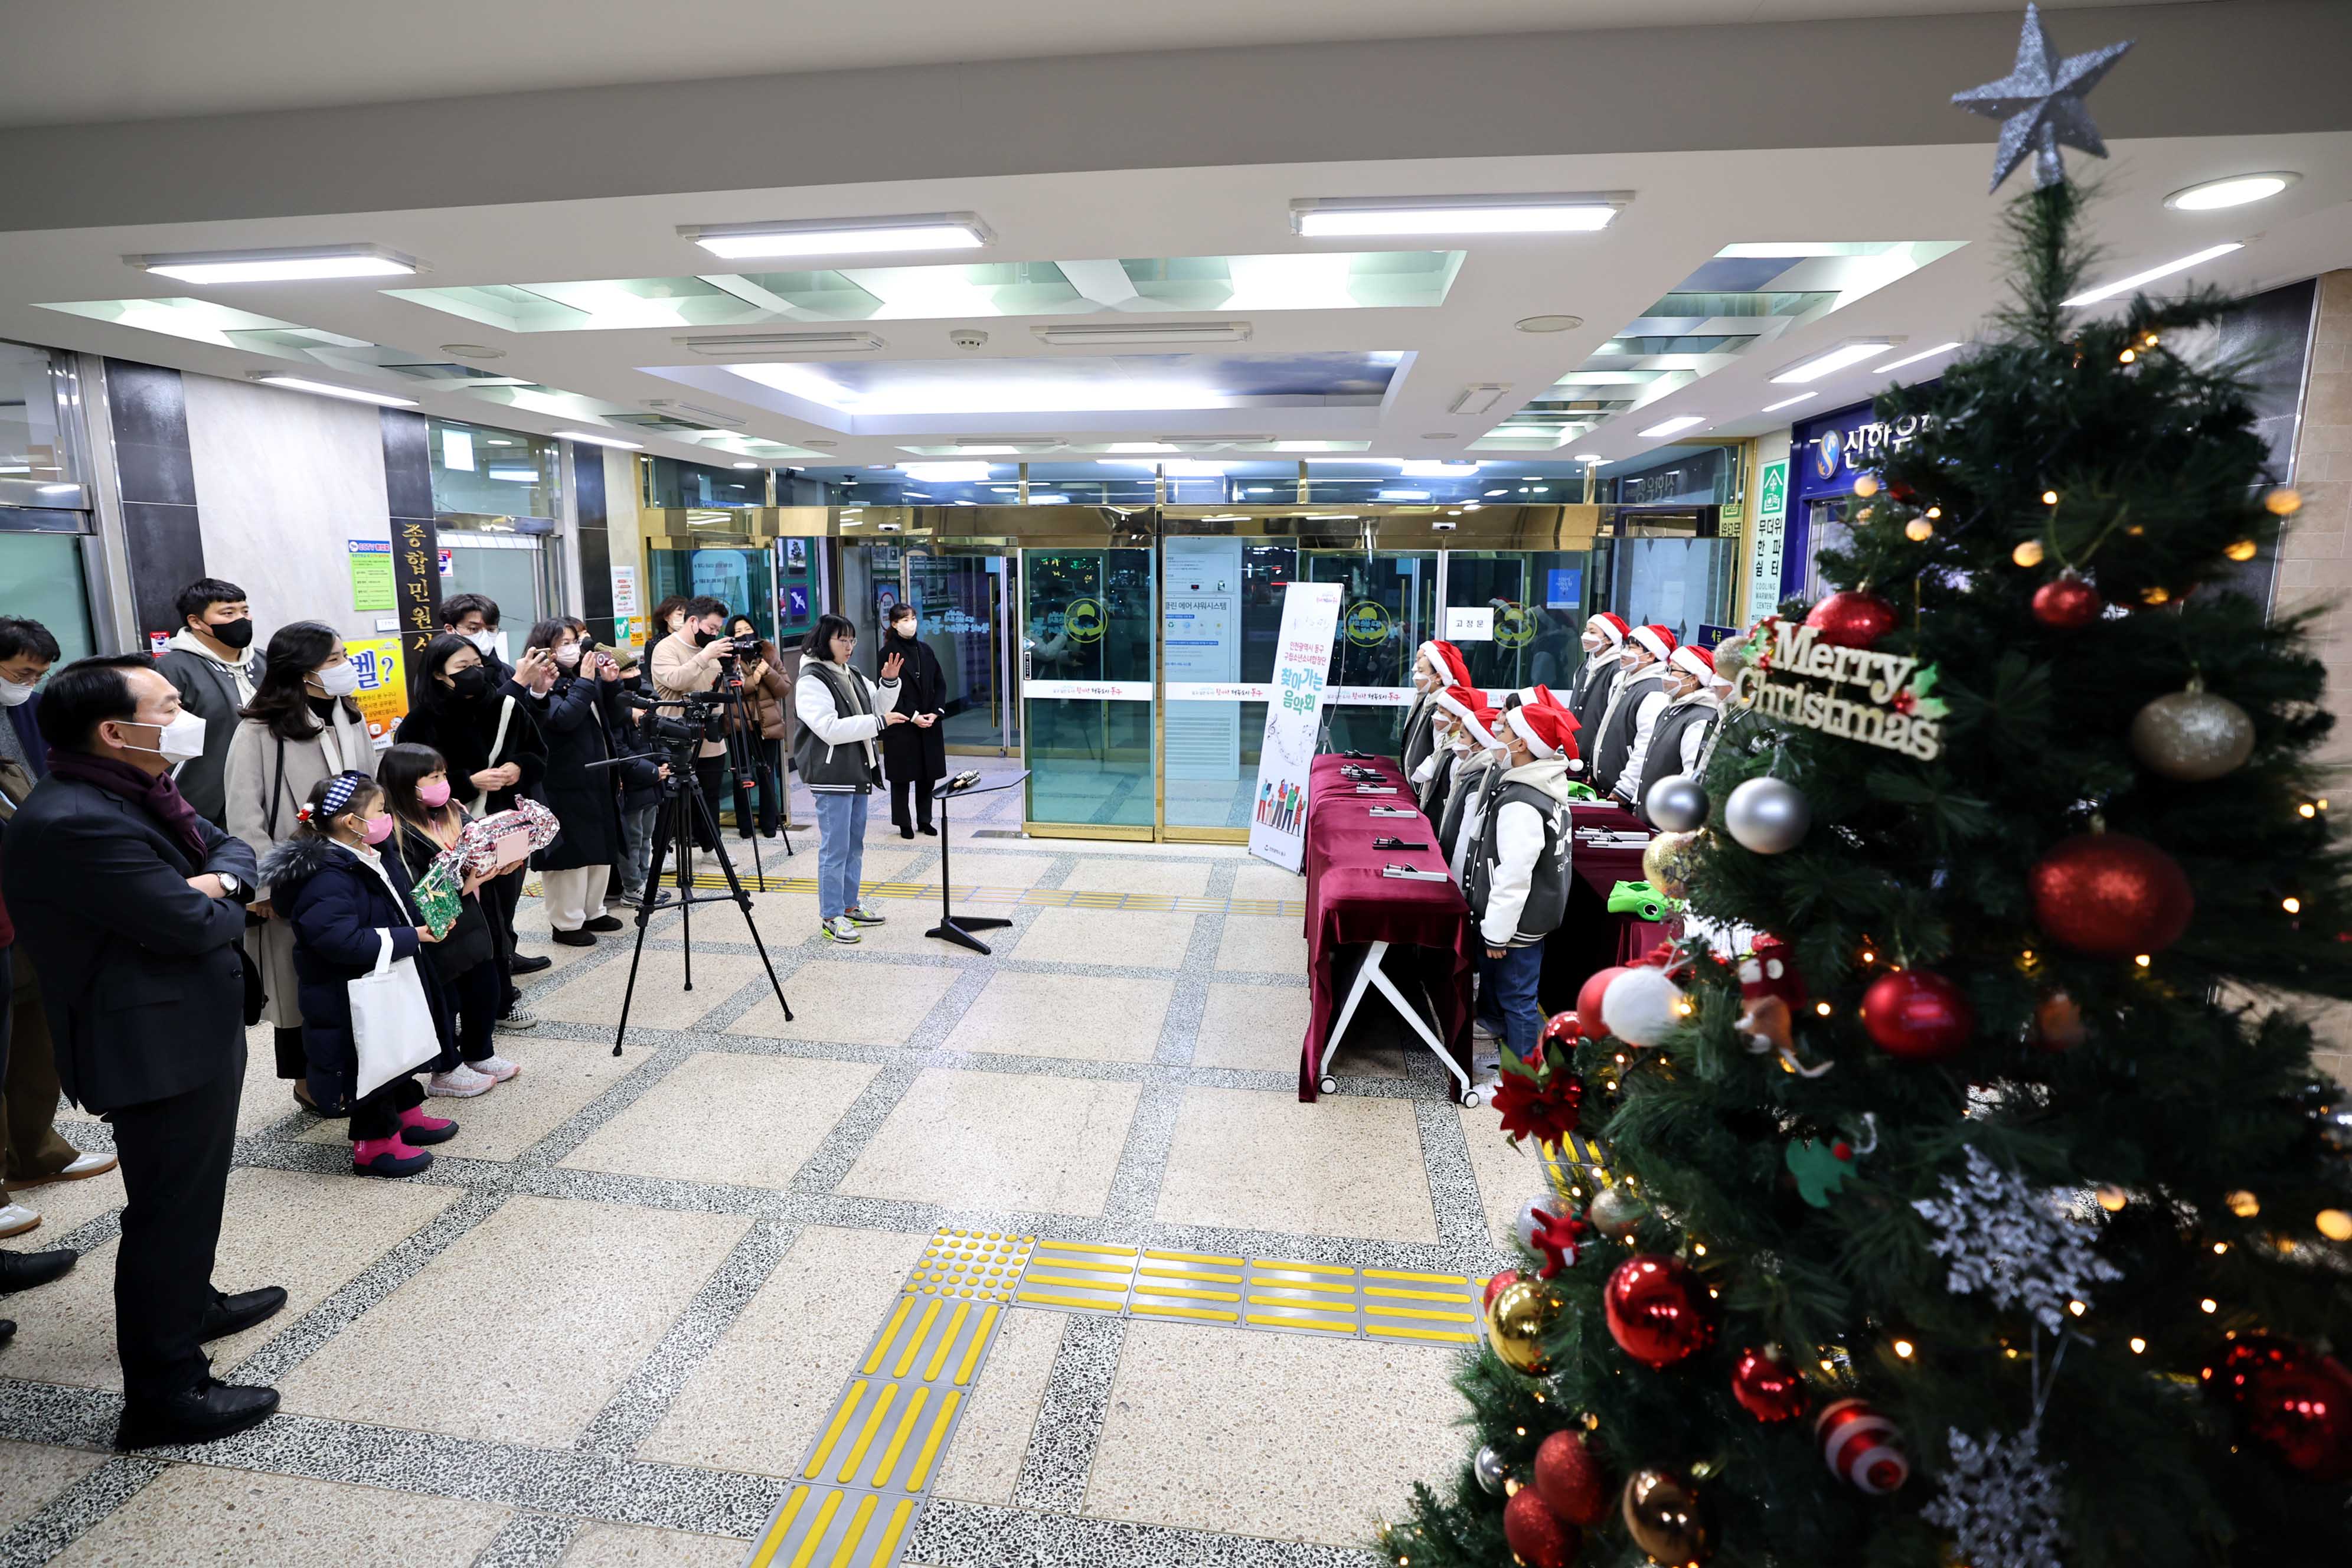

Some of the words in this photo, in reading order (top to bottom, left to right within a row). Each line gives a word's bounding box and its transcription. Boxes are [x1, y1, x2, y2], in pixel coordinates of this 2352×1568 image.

[1759, 517, 1782, 536] 무더위
[1756, 582, 1776, 590] COOLING
[1756, 592, 1775, 600] WARMING
[1178, 601, 1193, 610] 에어
[1193, 601, 1227, 610] 샤워시스템
[1756, 602, 1772, 610] CENTER
[1455, 619, 1484, 628] 고정문
[1290, 642, 1314, 652] 인천광역시
[1315, 644, 1324, 654] 동구
[1284, 652, 1327, 666] 구립소년소녀합창단
[1772, 621, 1918, 705] Merry
[1281, 668, 1323, 691] 찾아가는
[1283, 690, 1316, 716] 음악회
[1735, 667, 1940, 761] Christmas
